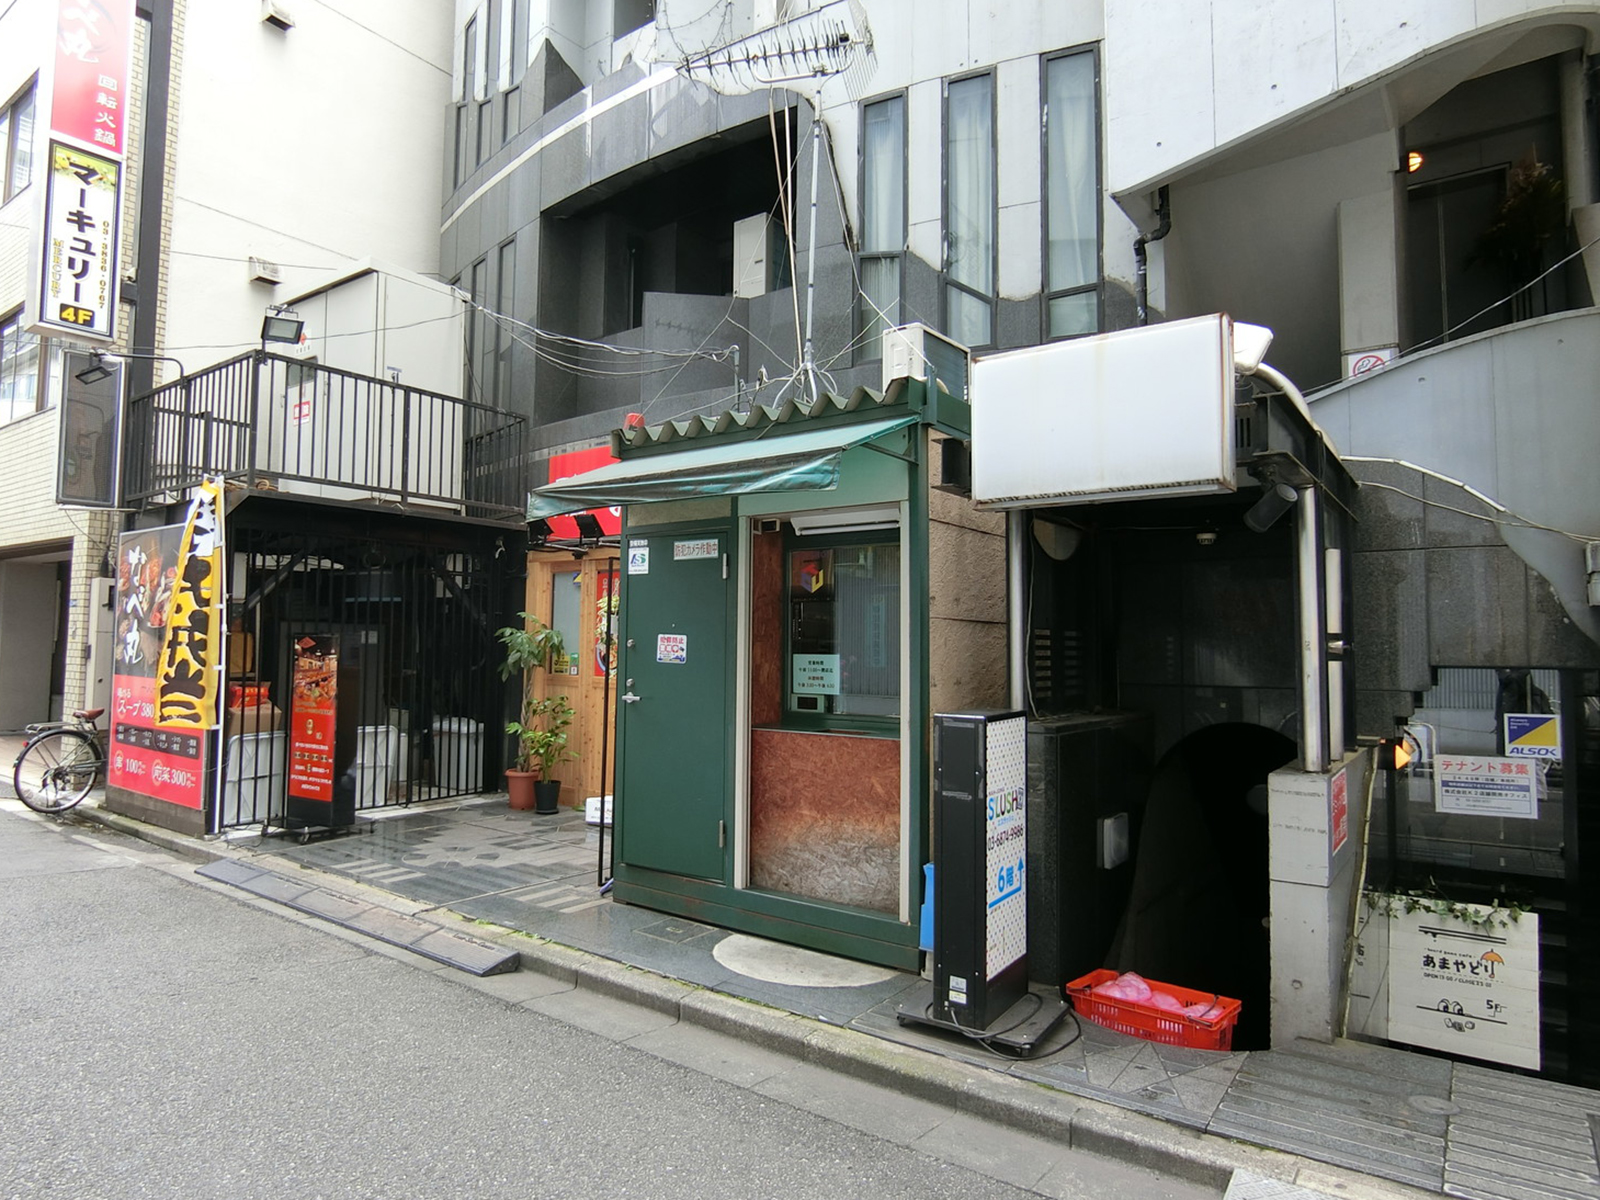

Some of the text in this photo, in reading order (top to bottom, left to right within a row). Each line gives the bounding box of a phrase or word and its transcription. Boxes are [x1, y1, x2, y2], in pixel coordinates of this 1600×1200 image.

[94, 73, 118, 147] 回転火鍋
[66, 161, 99, 303] マーキュリー
[51, 237, 64, 298] MERCURY
[60, 307, 94, 326] 4F
[675, 541, 718, 556] 防犯カメラ作動中
[123, 545, 148, 664] なべ丸
[1509, 746, 1557, 757] ALSOK
[125, 758, 139, 774] 100
[1441, 760, 1530, 775] テナント募集
[171, 769, 187, 786] 300
[997, 865, 1014, 893] 6階
[1423, 954, 1495, 978] あまやどり
[1486, 999, 1500, 1012] 5F
